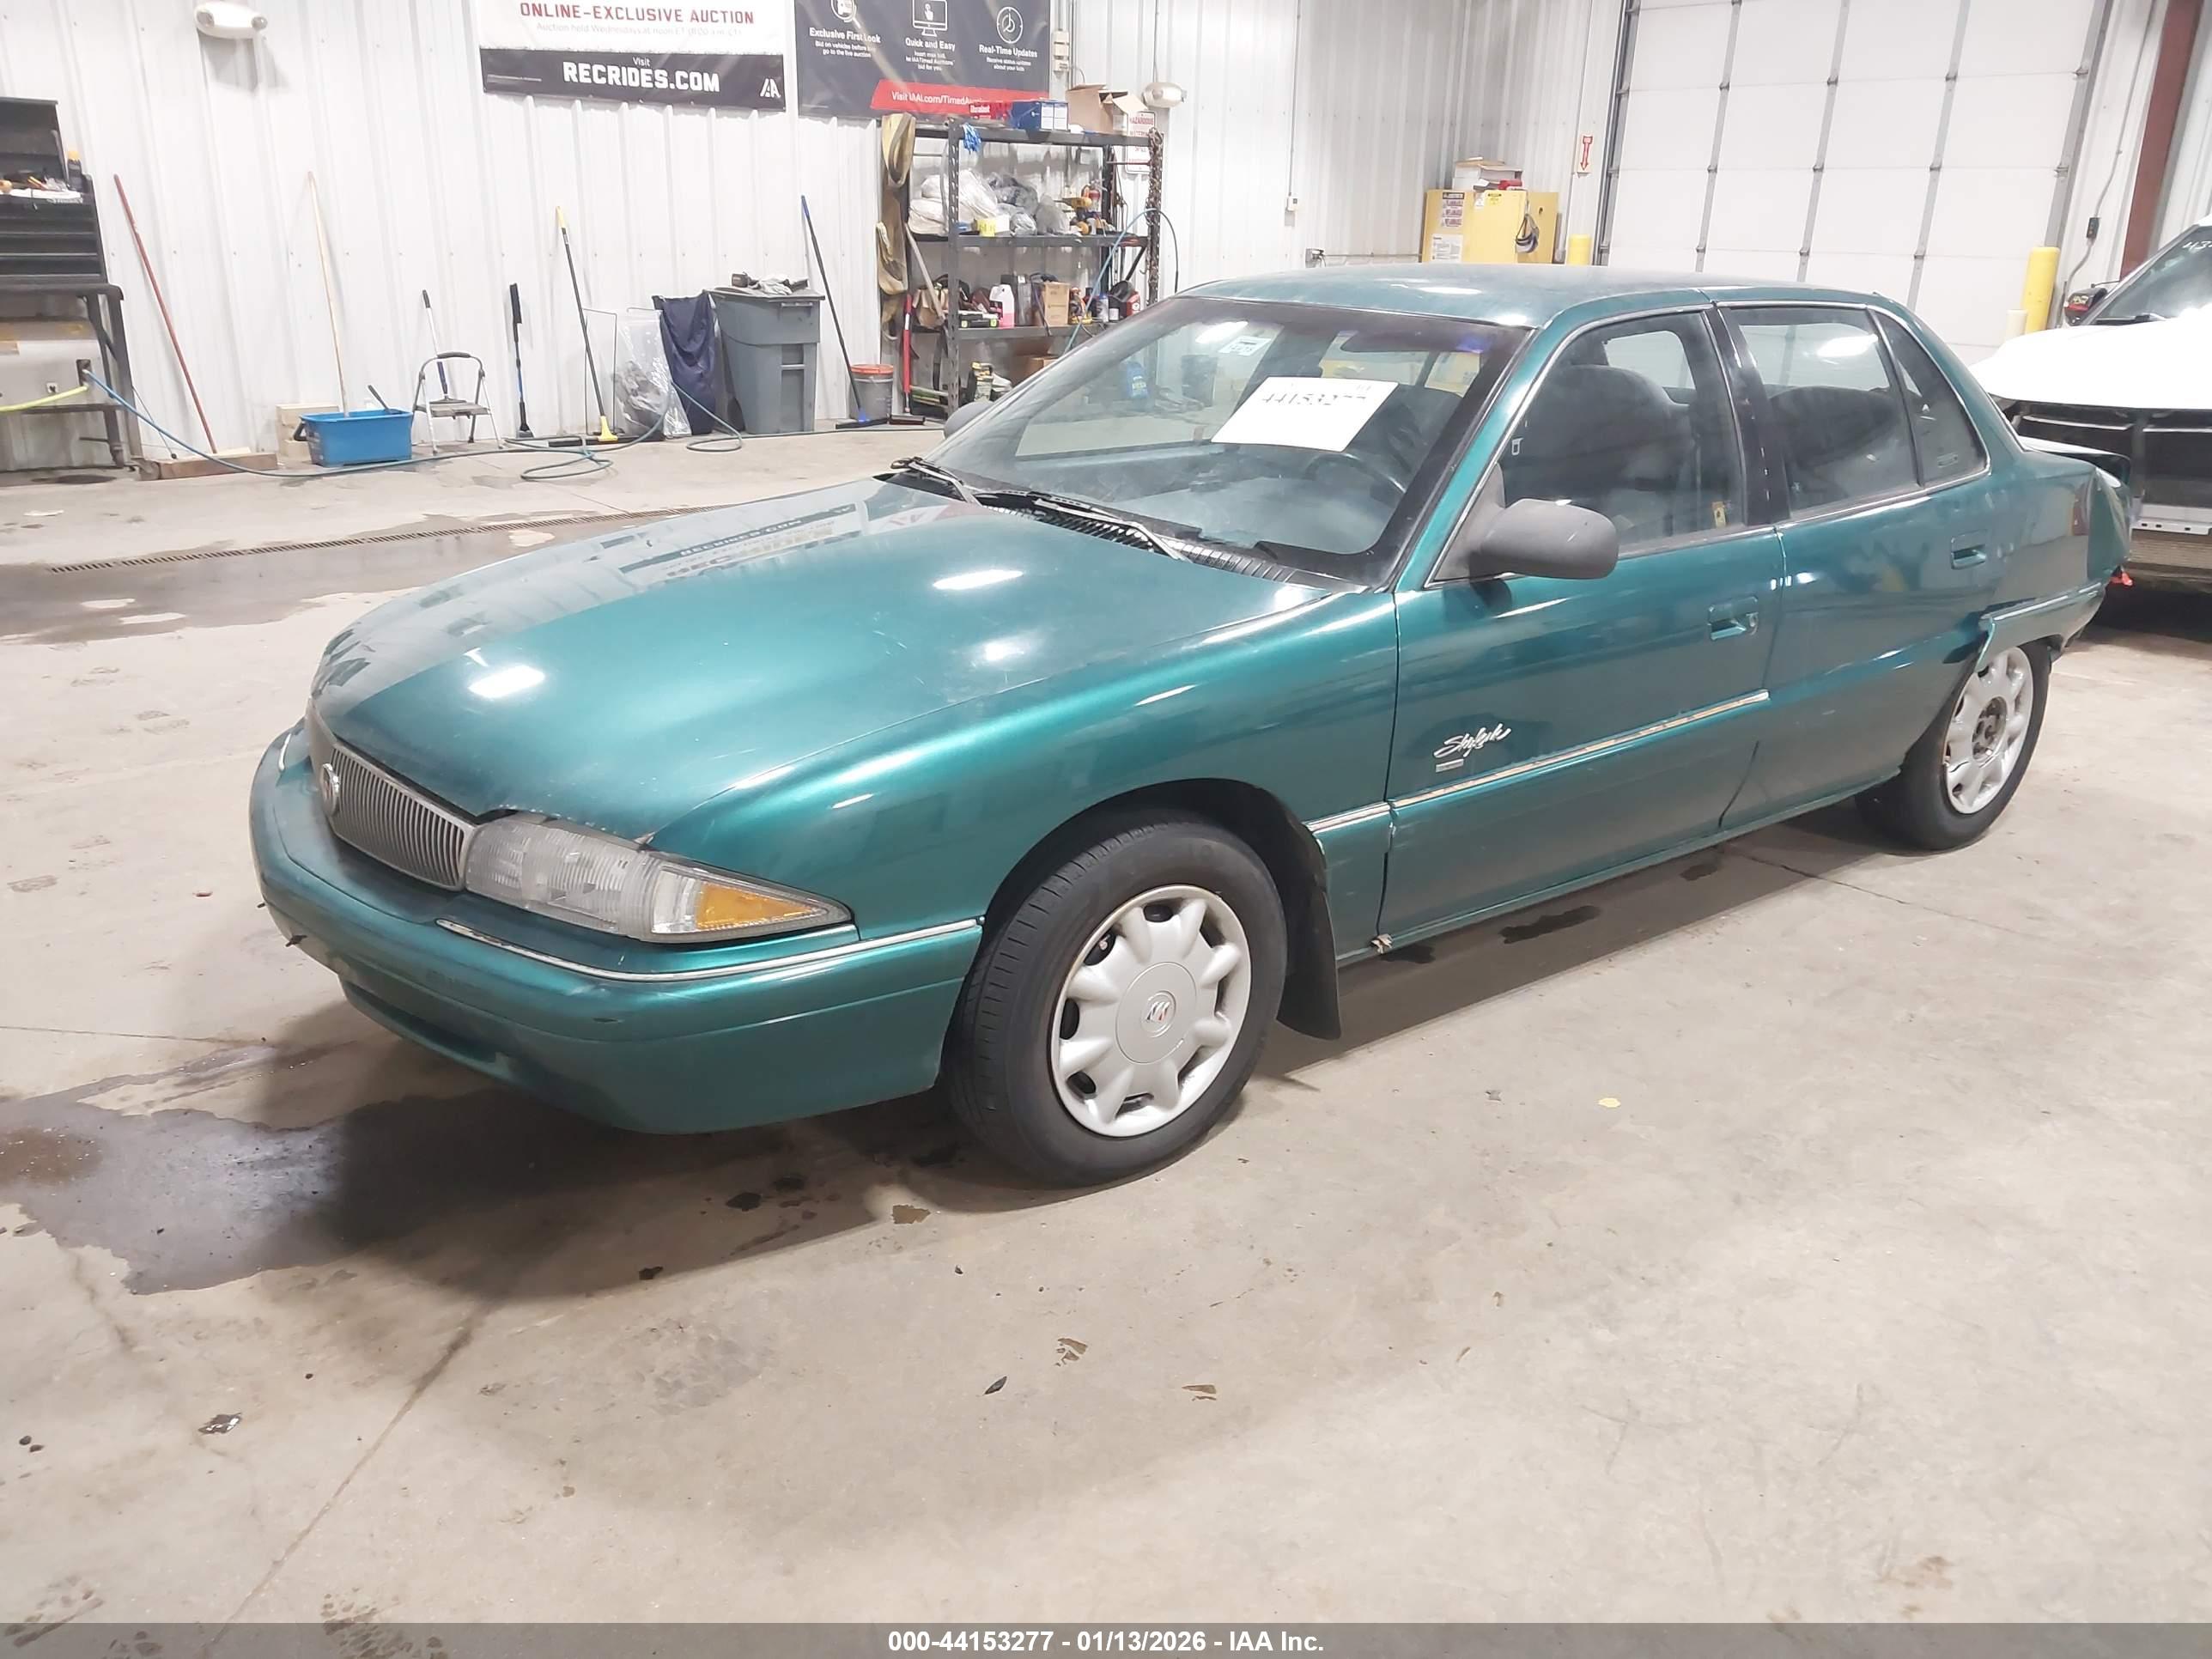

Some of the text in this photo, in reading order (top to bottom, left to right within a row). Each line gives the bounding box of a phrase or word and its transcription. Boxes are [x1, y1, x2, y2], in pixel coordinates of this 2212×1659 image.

[520, 3, 755, 24] ONLINE-EXCLUSIVE AUCTION
[809, 27, 845, 40] Exclusive
[905, 37, 955, 52] Quick and Easy
[979, 44, 1037, 58] Real-Time Updates
[632, 57, 651, 67] Visit
[562, 62, 720, 92] RECRIDES.COM
[891, 90, 908, 101] Visit
[1433, 722, 1512, 758] Skylark
